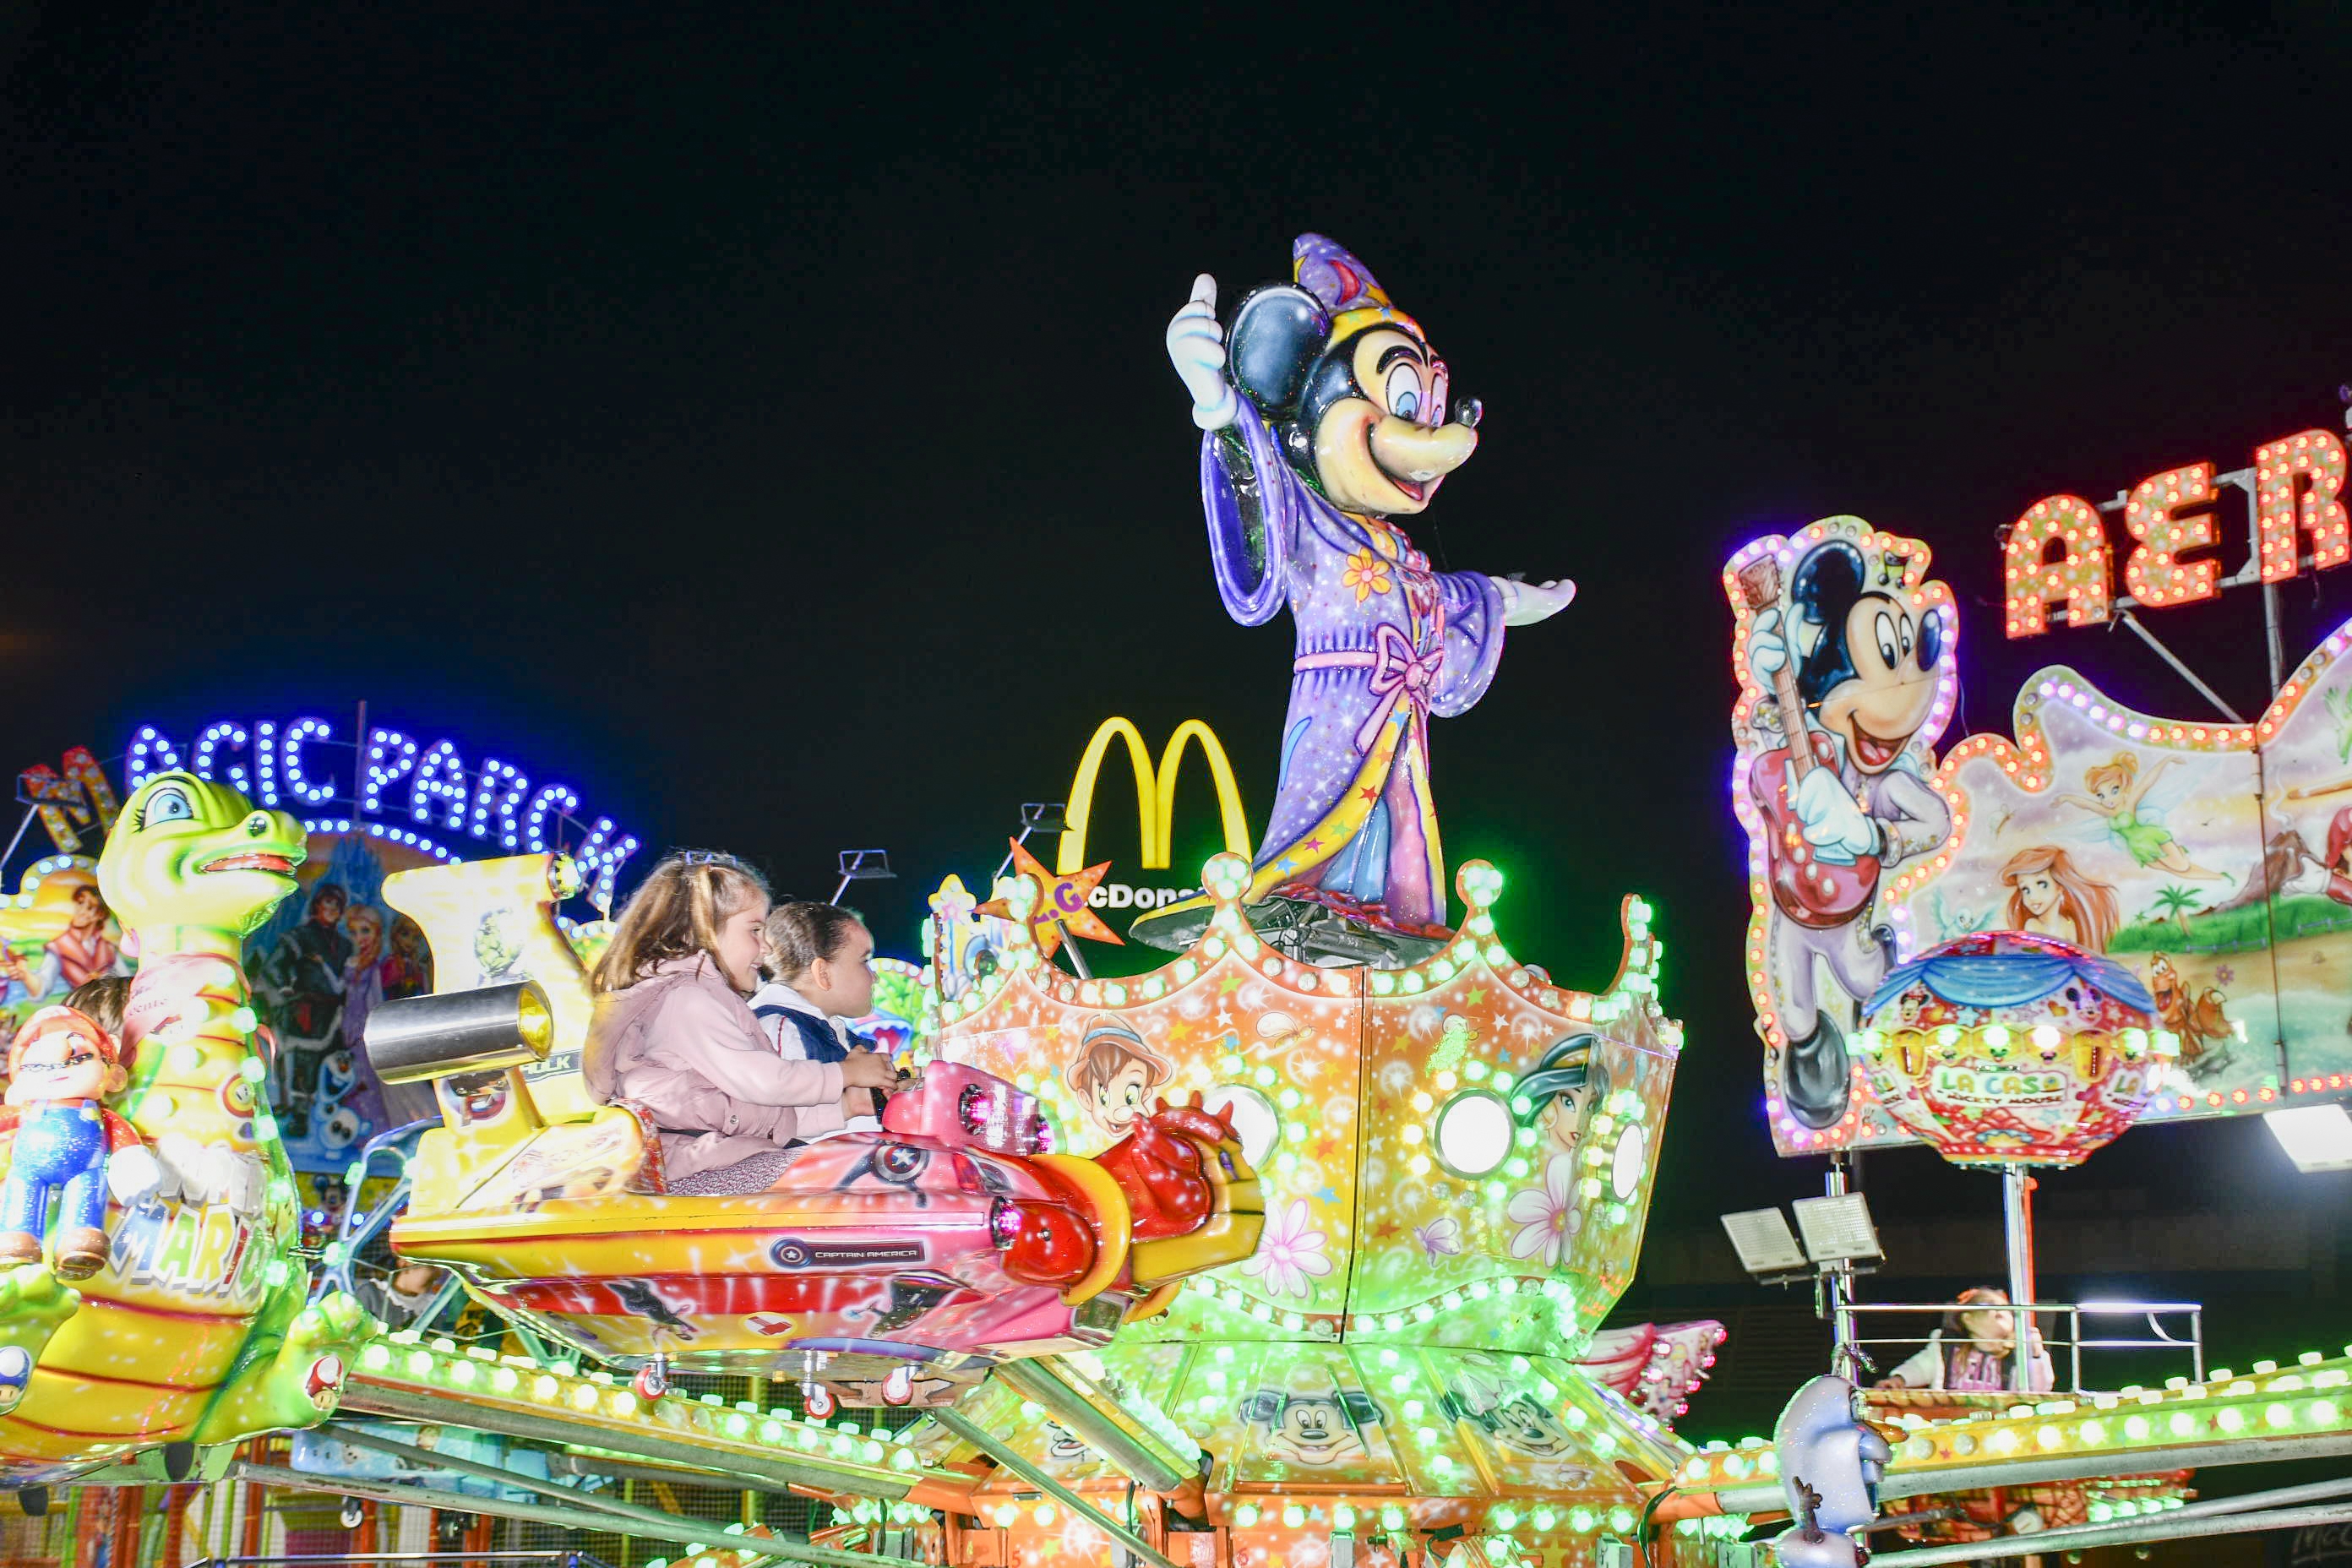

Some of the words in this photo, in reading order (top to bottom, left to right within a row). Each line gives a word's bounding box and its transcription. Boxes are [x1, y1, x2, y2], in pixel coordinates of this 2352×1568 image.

[21, 716, 336, 853] MAGIC
[362, 727, 640, 907] PARCK
[1087, 884, 1204, 908] cDon
[1941, 1072, 1974, 1093] LA
[109, 1200, 268, 1298] MARIO
